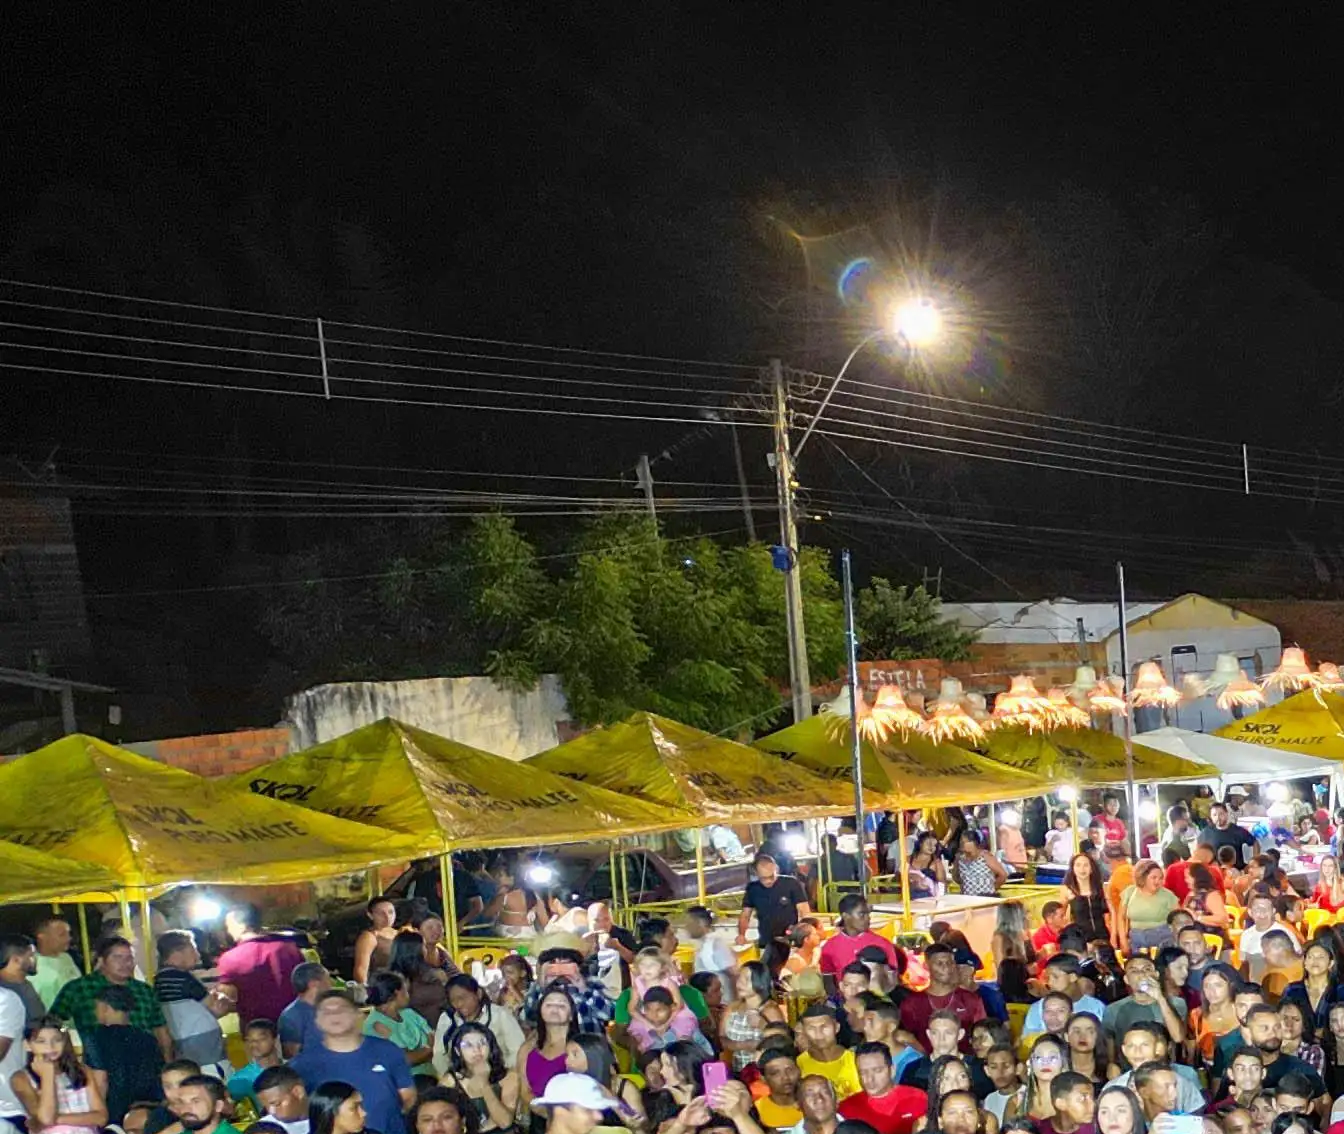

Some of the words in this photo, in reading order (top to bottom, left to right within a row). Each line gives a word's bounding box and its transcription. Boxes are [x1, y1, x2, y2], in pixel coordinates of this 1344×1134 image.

[1240, 722, 1282, 734] SKOL
[1278, 735, 1325, 745] MALTE
[229, 820, 309, 843] MALTE
